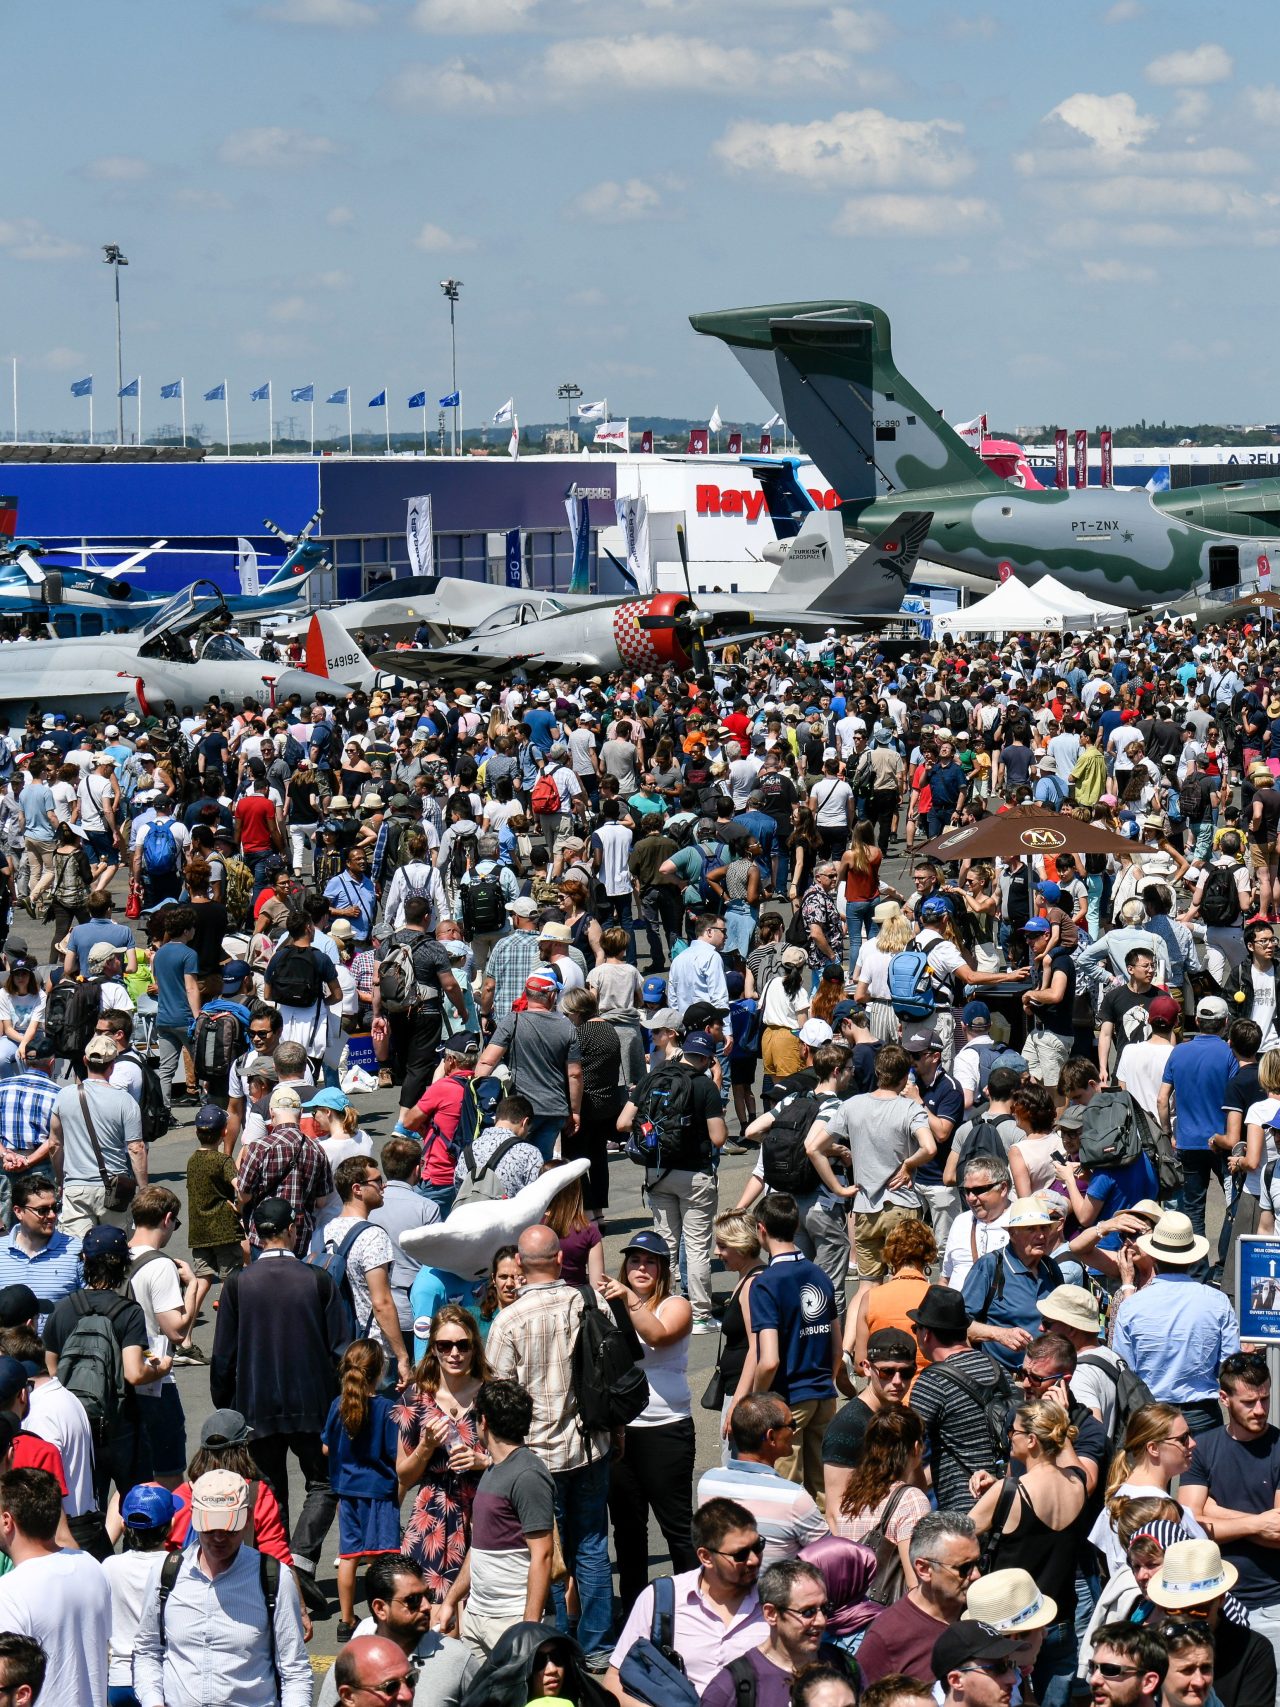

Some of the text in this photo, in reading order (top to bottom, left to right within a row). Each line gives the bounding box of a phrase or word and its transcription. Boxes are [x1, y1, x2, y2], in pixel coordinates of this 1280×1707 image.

[1071, 521, 1120, 532] PT-ZNX
[327, 652, 360, 670] 549192
[350, 1049, 373, 1057] UELED
